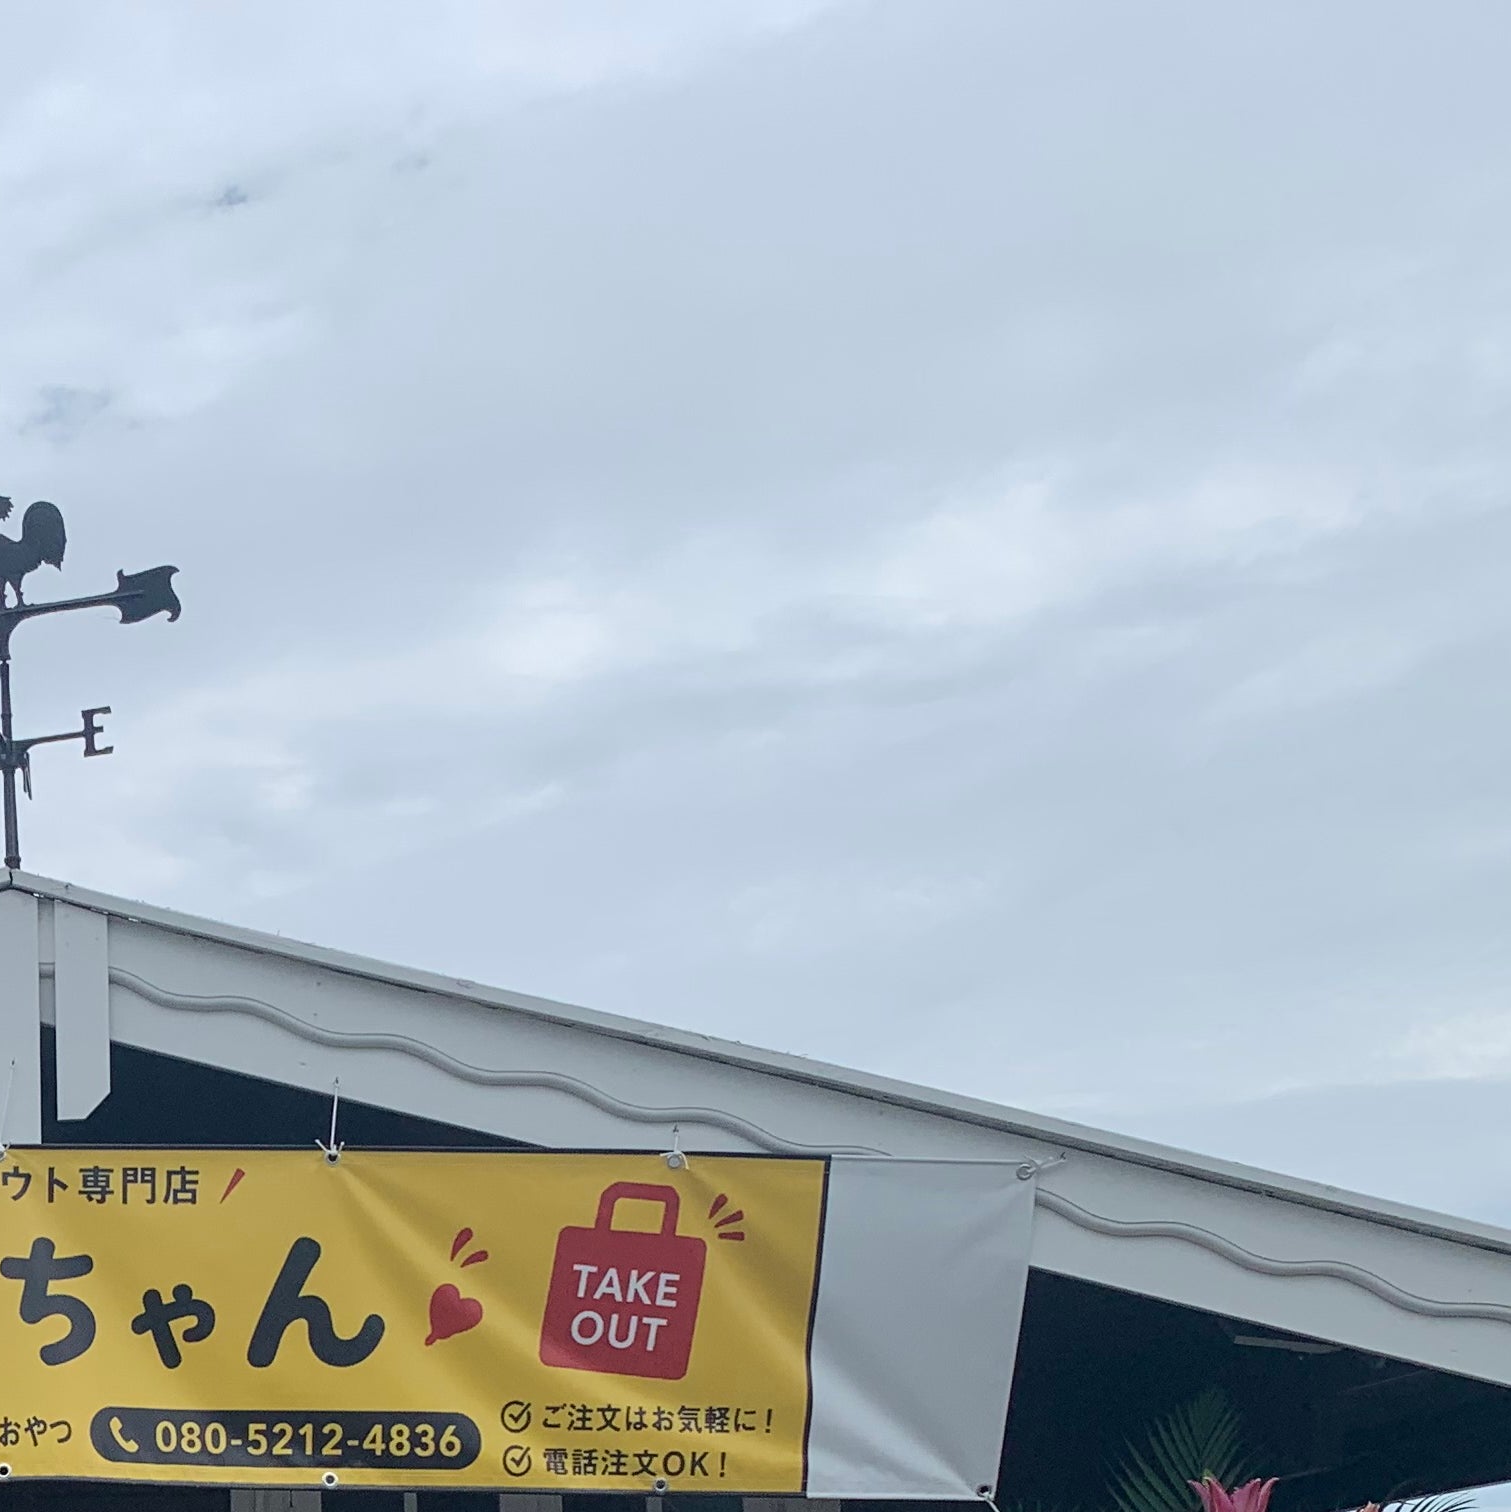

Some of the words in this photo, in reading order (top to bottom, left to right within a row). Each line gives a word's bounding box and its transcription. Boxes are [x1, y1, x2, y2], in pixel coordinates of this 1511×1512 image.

[80, 705, 115, 758] E
[571, 1263, 680, 1309] TAKE
[571, 1312, 669, 1352] OUT
[154, 1419, 463, 1460] 080-5212-4836
